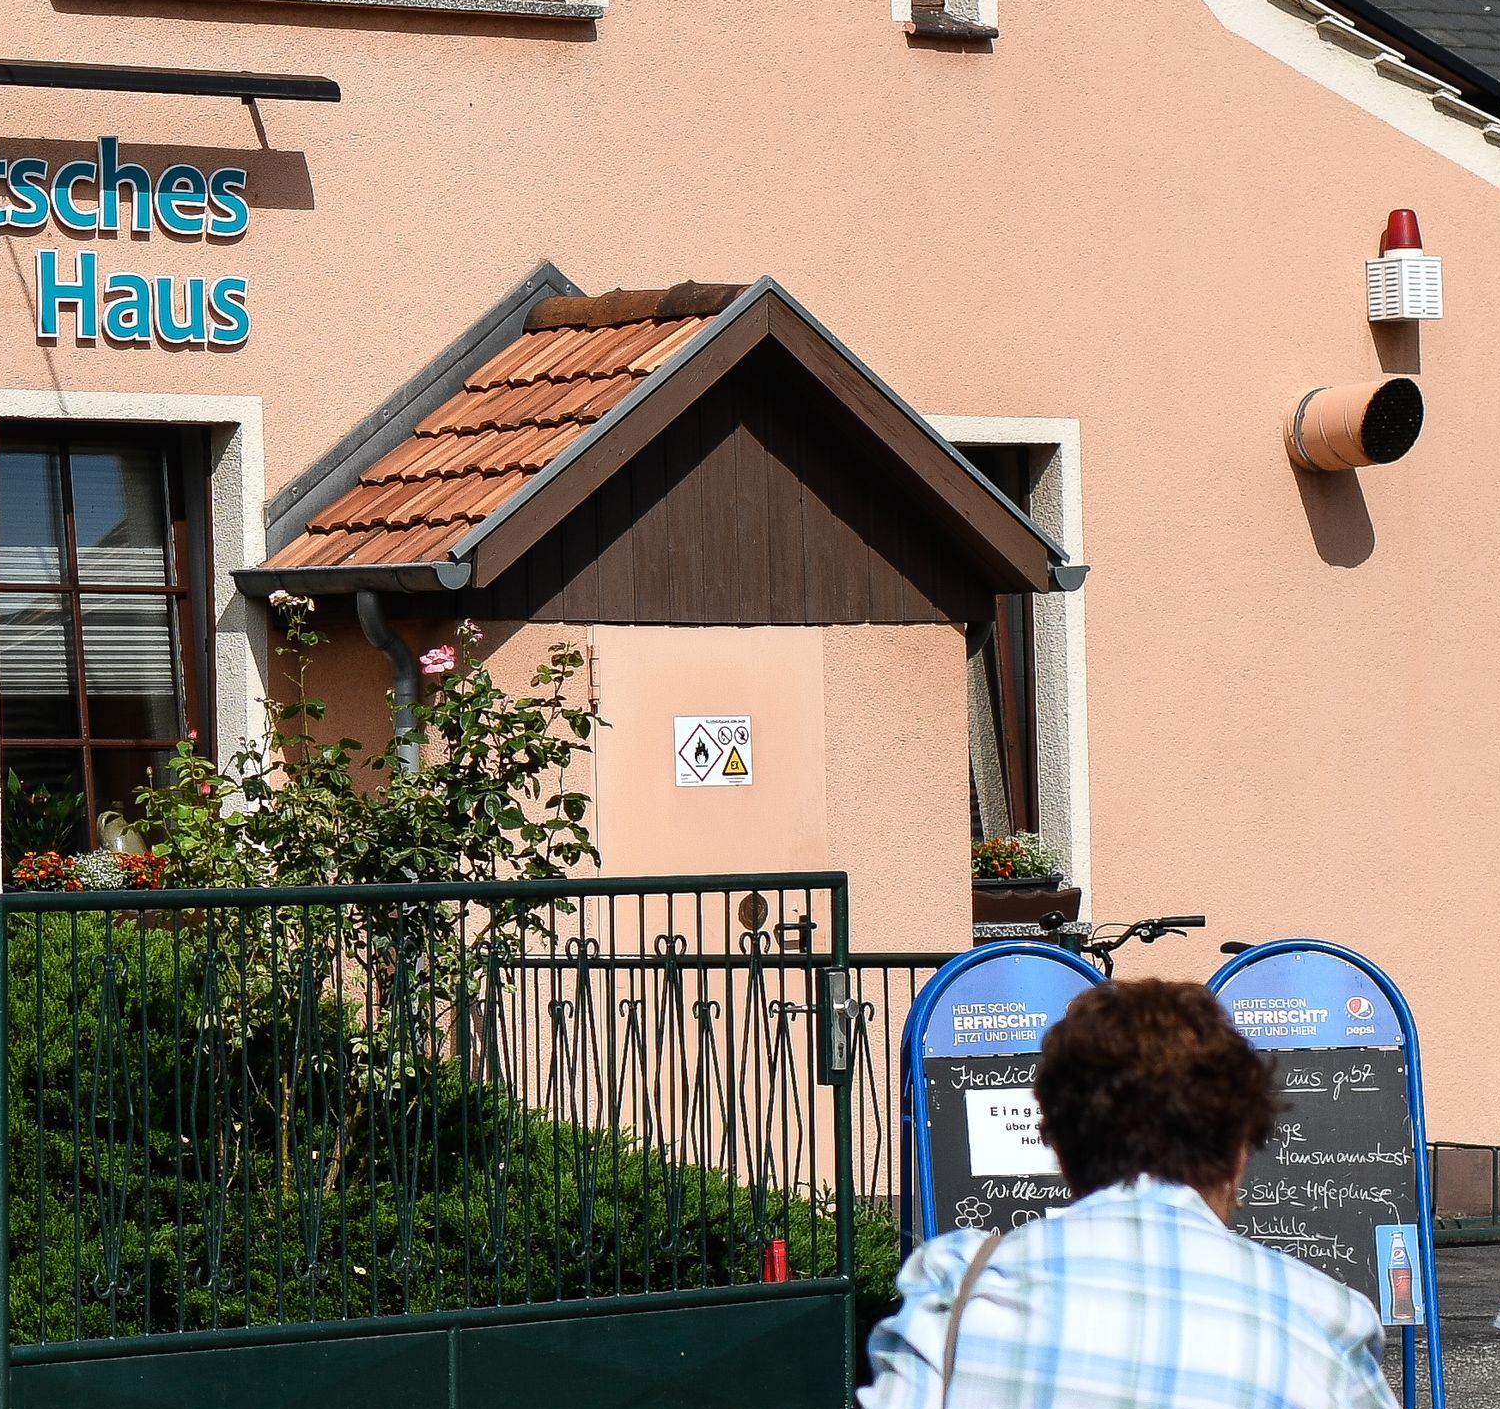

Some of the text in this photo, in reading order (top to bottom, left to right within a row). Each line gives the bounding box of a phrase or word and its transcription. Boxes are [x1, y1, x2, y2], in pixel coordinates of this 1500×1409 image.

[35, 247, 251, 347] Haus
[952, 1002, 1026, 1015] HEUTE SCHON
[1232, 998, 1307, 1010] HEUTE SCHON
[953, 1013, 1048, 1031] ERFRISCHT?
[1233, 1009, 1329, 1025] ERFRISCHT?
[1235, 1025, 1317, 1037] ETZT UND HIER!
[1346, 1024, 1376, 1036] pepsi
[953, 1030, 1037, 1047] JETZT UND HIER!
[1005, 1122, 1031, 1131] über
